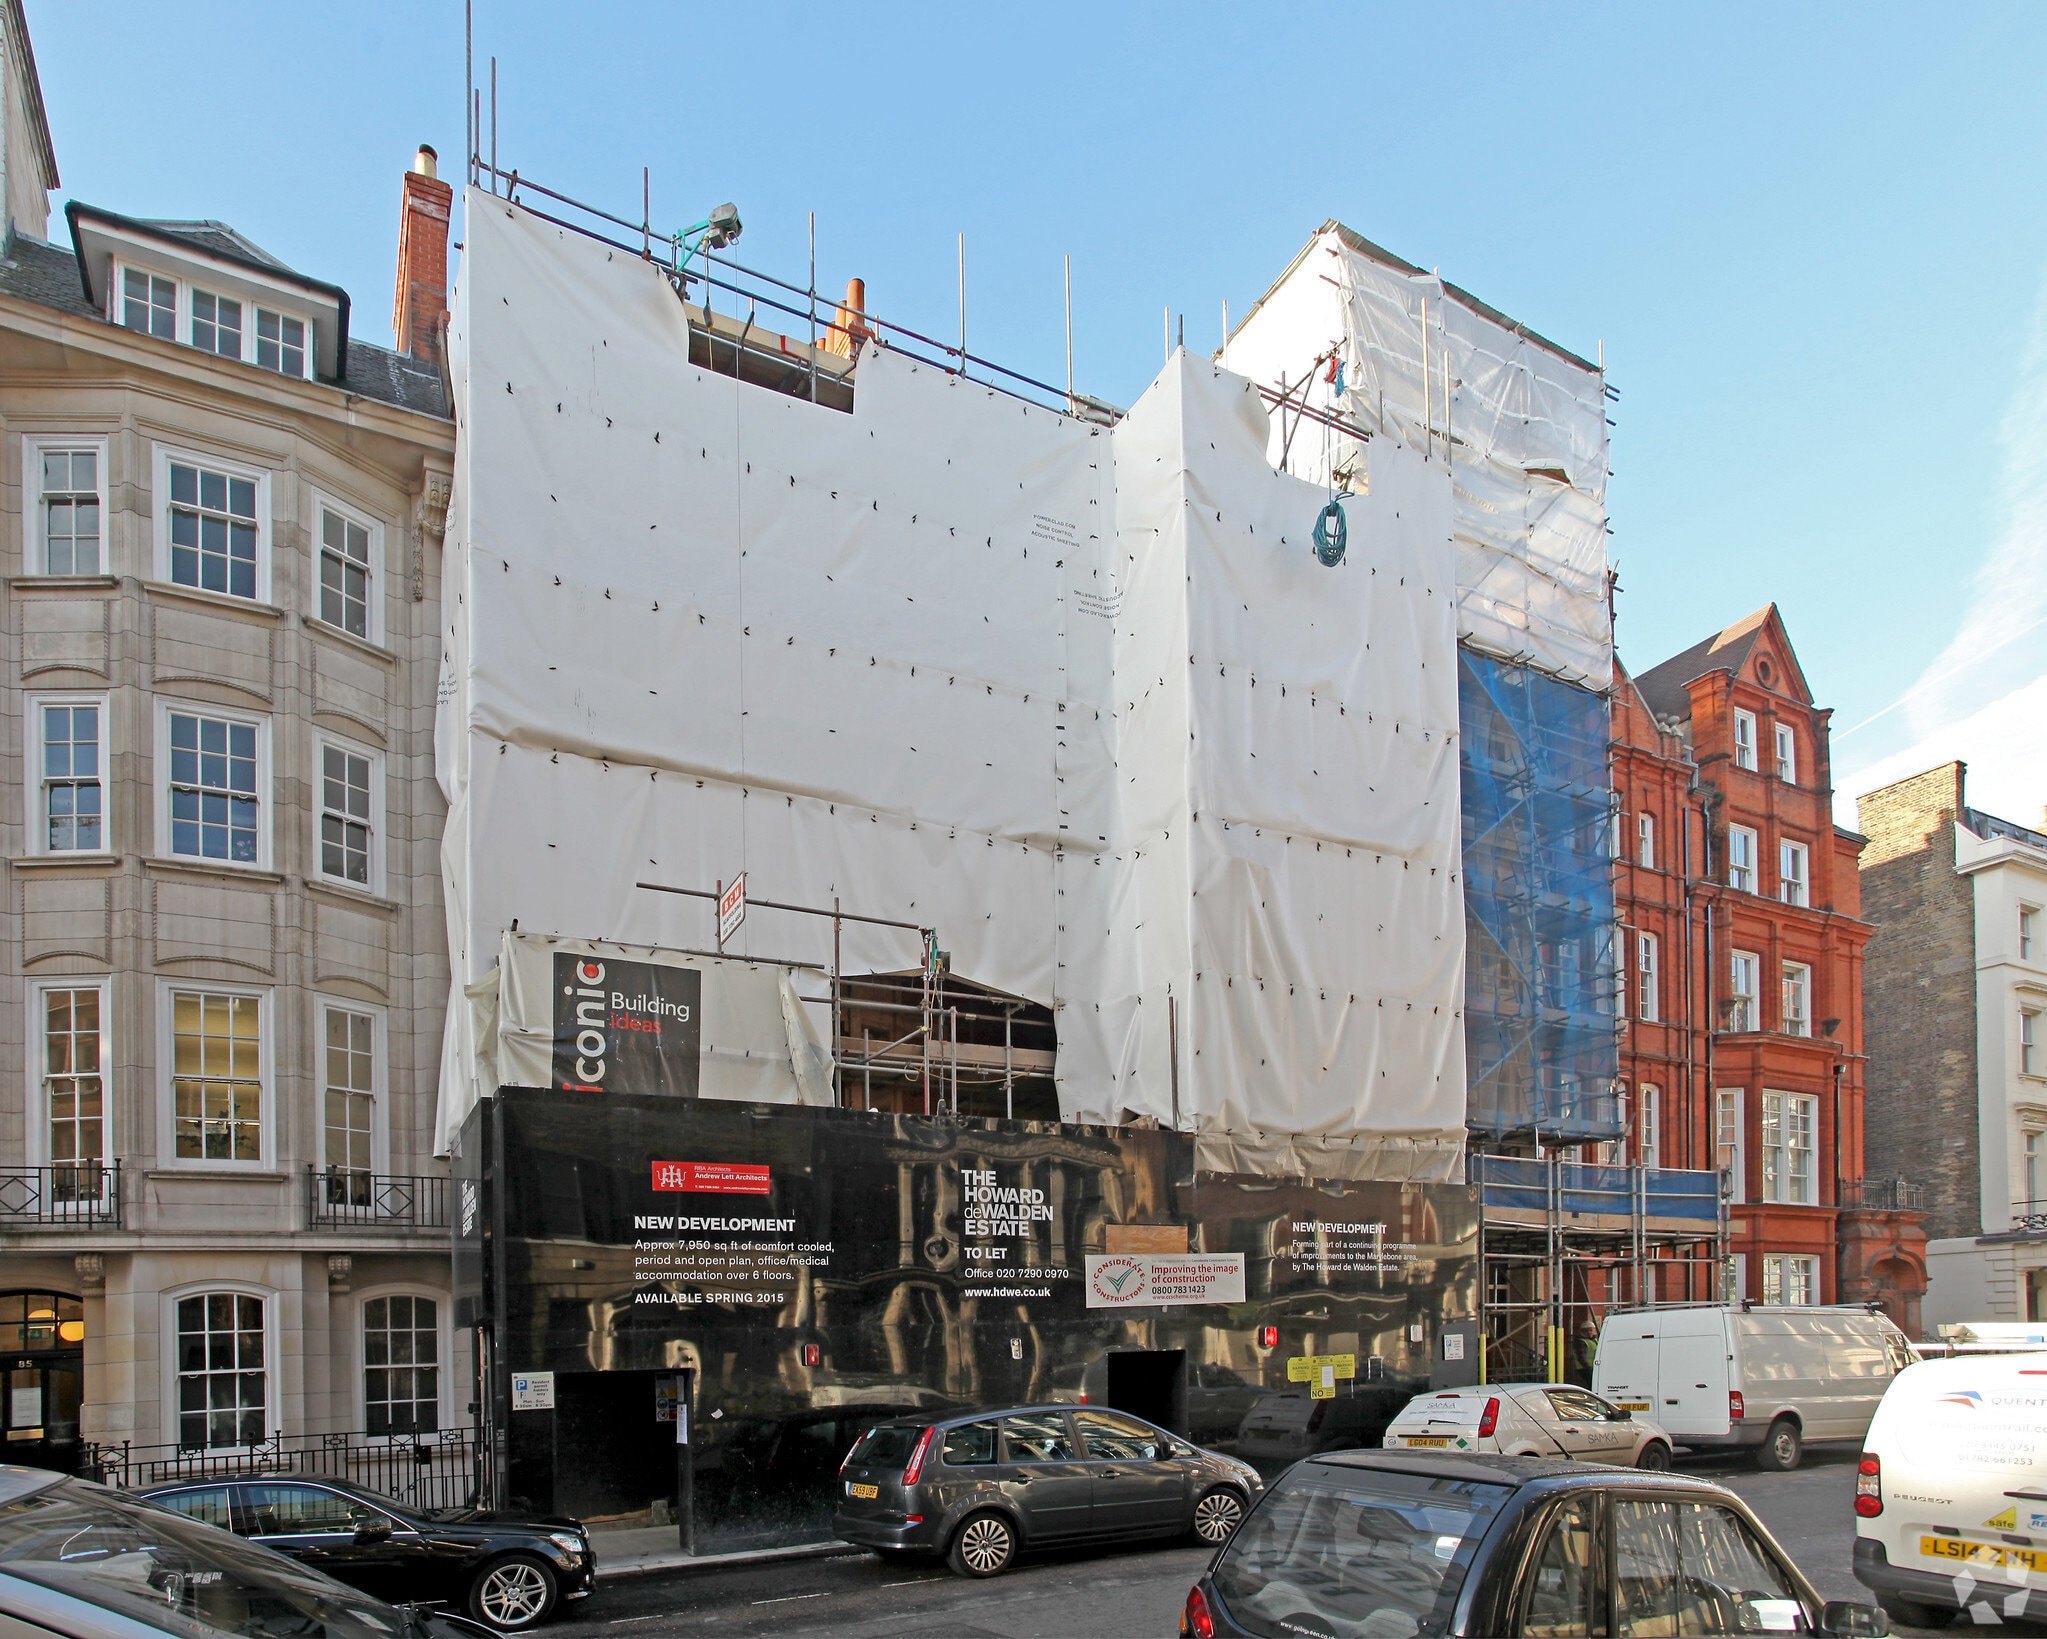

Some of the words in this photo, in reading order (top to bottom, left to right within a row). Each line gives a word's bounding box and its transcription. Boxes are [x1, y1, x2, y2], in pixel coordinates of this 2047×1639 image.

[1035, 523, 1050, 531] NOISE
[1051, 528, 1073, 538] CONTROL
[1031, 531, 1055, 541] ACOUSTIC
[1056, 538, 1080, 547] SHEETING
[611, 992, 690, 1022] Building
[562, 960, 606, 1093] iconic
[610, 1012, 662, 1034] ideas
[695, 1172, 720, 1180] Andrew
[735, 1174, 768, 1182] Architects
[961, 1170, 997, 1186] THE
[964, 1187, 1045, 1204] HOWARD
[964, 1203, 1054, 1221] deWALDEN
[634, 1216, 674, 1230] NEW
[677, 1217, 796, 1232] DEVELOPMENT
[965, 1220, 1030, 1236] ESTATE
[1292, 1222, 1316, 1233] NEW
[1318, 1222, 1387, 1234] DEVELOPMENT
[634, 1240, 675, 1252] Approx
[678, 1240, 711, 1251] 7,950
[714, 1242, 727, 1252] sq
[730, 1240, 738, 1250] ft
[741, 1241, 752, 1251] of
[754, 1241, 795, 1251] comfort
[797, 1242, 835, 1253] cooled,
[1292, 1240, 1319, 1250] Forming
[1319, 1241, 1334, 1250] part
[1349, 1241, 1381, 1251] continuing
[1382, 1243, 1417, 1251] programme
[964, 1247, 982, 1259] TO
[985, 1247, 1007, 1259] LET
[1301, 1252, 1346, 1260] improvements
[1355, 1252, 1365, 1260] the
[1367, 1252, 1402, 1261] Marylebone
[635, 1255, 671, 1267] period
[674, 1255, 695, 1265] and
[698, 1257, 725, 1267] open
[728, 1256, 754, 1267] plan,
[757, 1255, 829, 1266] office/medical
[965, 1268, 994, 1278] Office
[996, 1269, 1015, 1278] 020
[1018, 1269, 1042, 1278] 7290
[1044, 1269, 1069, 1279] 0970
[1093, 1259, 1146, 1279] CONSIDERATE
[1151, 1264, 1196, 1276] Improving
[1198, 1264, 1212, 1273] the
[1213, 1264, 1239, 1274] image
[1292, 1263, 1301, 1272] by
[1302, 1263, 1315, 1271] The
[1316, 1263, 1341, 1271] Howard
[1343, 1263, 1352, 1271] de
[1352, 1263, 1377, 1271] Walden
[1379, 1263, 1400, 1271] Estate.
[635, 1270, 723, 1280] accommodation
[726, 1272, 749, 1280] over
[752, 1271, 760, 1280] 6
[763, 1270, 795, 1280] floors.
[1151, 1274, 1162, 1283] of
[1163, 1274, 1216, 1283] construction
[964, 1286, 1051, 1297] www.hdwe.co.uk
[1093, 1282, 1145, 1302] CONSTRUCTORS
[1151, 1286, 1172, 1294] 0800
[1173, 1286, 1187, 1294] 783
[1188, 1285, 1206, 1293] 1423
[634, 1293, 702, 1304] AVAILABLE
[705, 1293, 753, 1303] SPRING
[756, 1293, 784, 1303] 2015
[18, 1360, 33, 1368] 85
[517, 1380, 526, 1390] P
[1312, 1389, 1324, 1398] NO
[1409, 1438, 1427, 1446] LG04
[1428, 1439, 1444, 1447] RUU
[1893, 1493, 1953, 1504] PEUGEOT
[1988, 1520, 2015, 1528] safe
[1933, 1539, 1980, 1560] LS14
